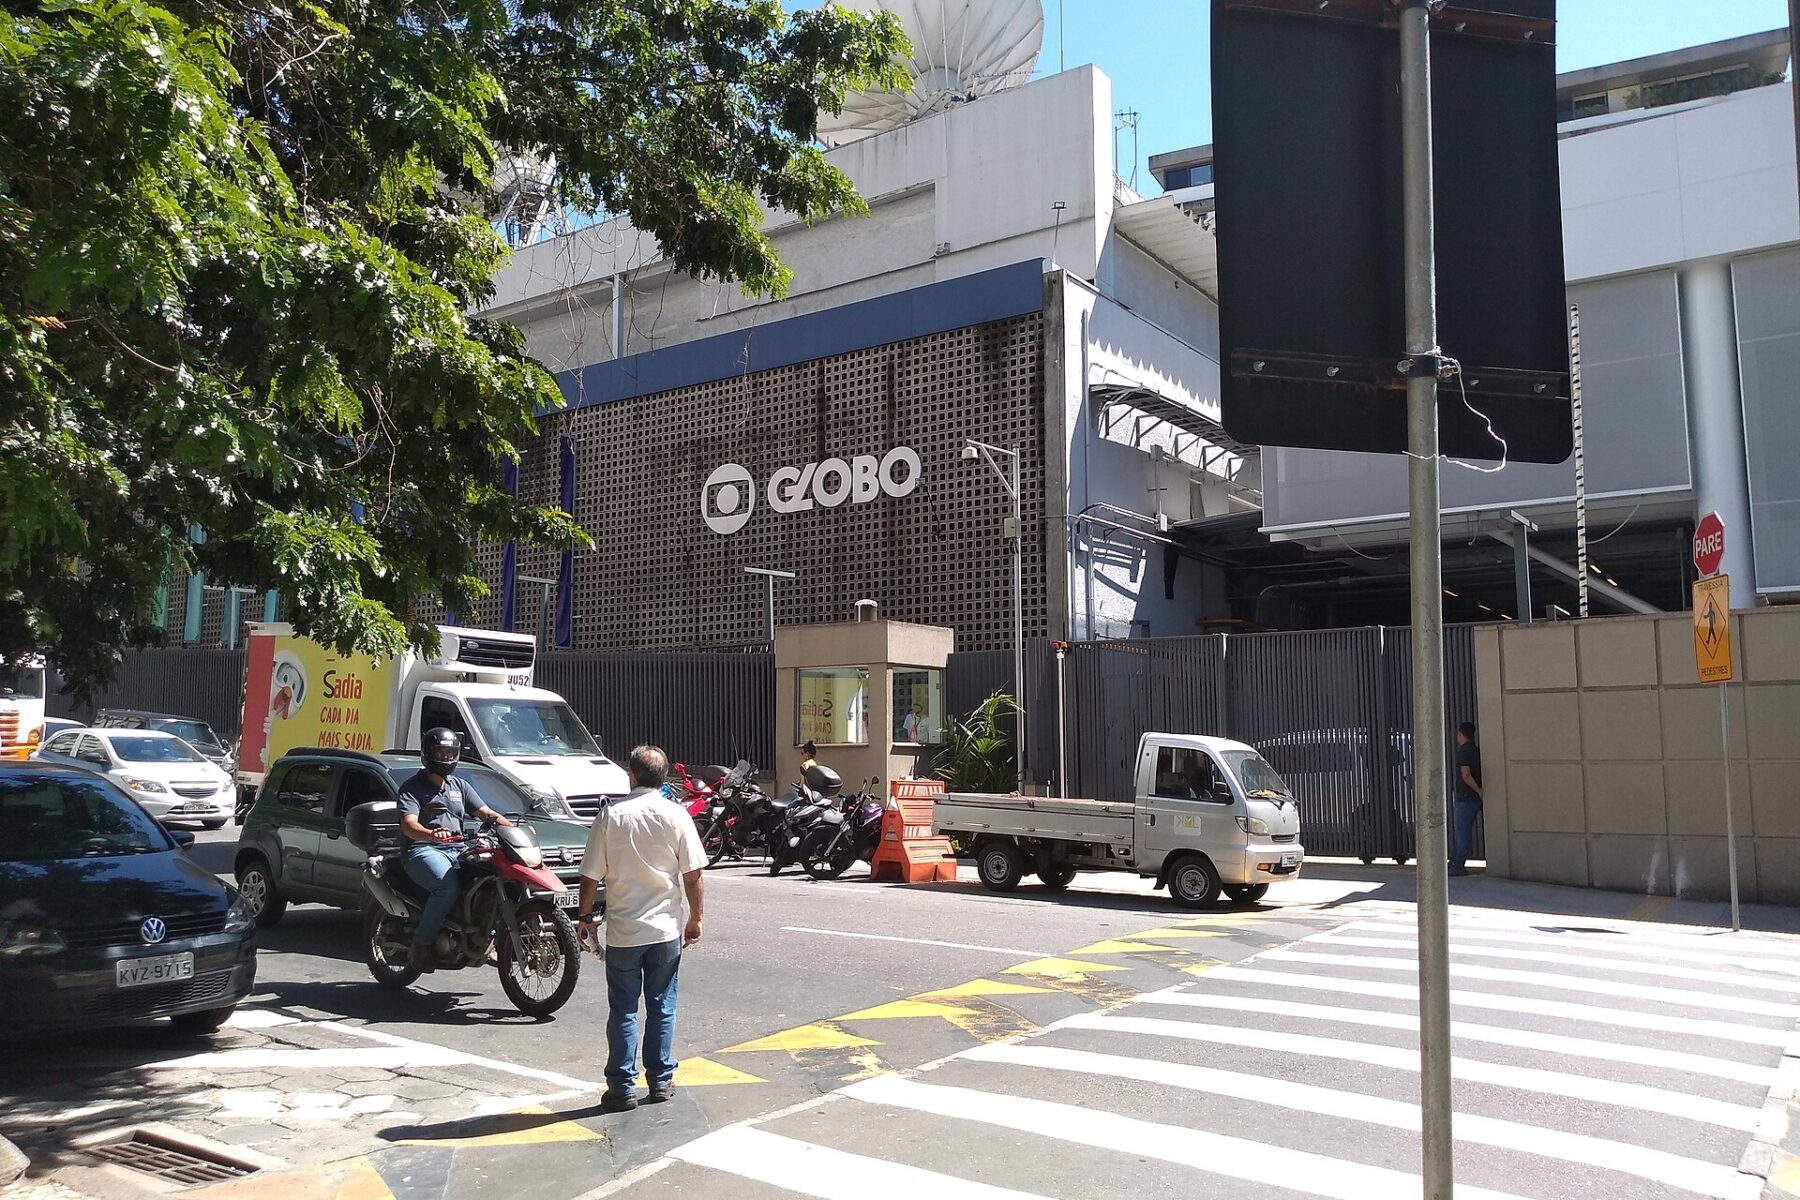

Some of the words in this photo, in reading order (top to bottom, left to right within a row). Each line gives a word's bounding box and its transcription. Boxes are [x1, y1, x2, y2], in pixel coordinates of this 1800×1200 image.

[768, 447, 922, 513] GLOBO
[1696, 531, 1722, 559] PARE
[323, 670, 363, 699] Sadia
[320, 706, 342, 724] CADA
[345, 707, 359, 724] DIA
[318, 730, 342, 748] MAIS
